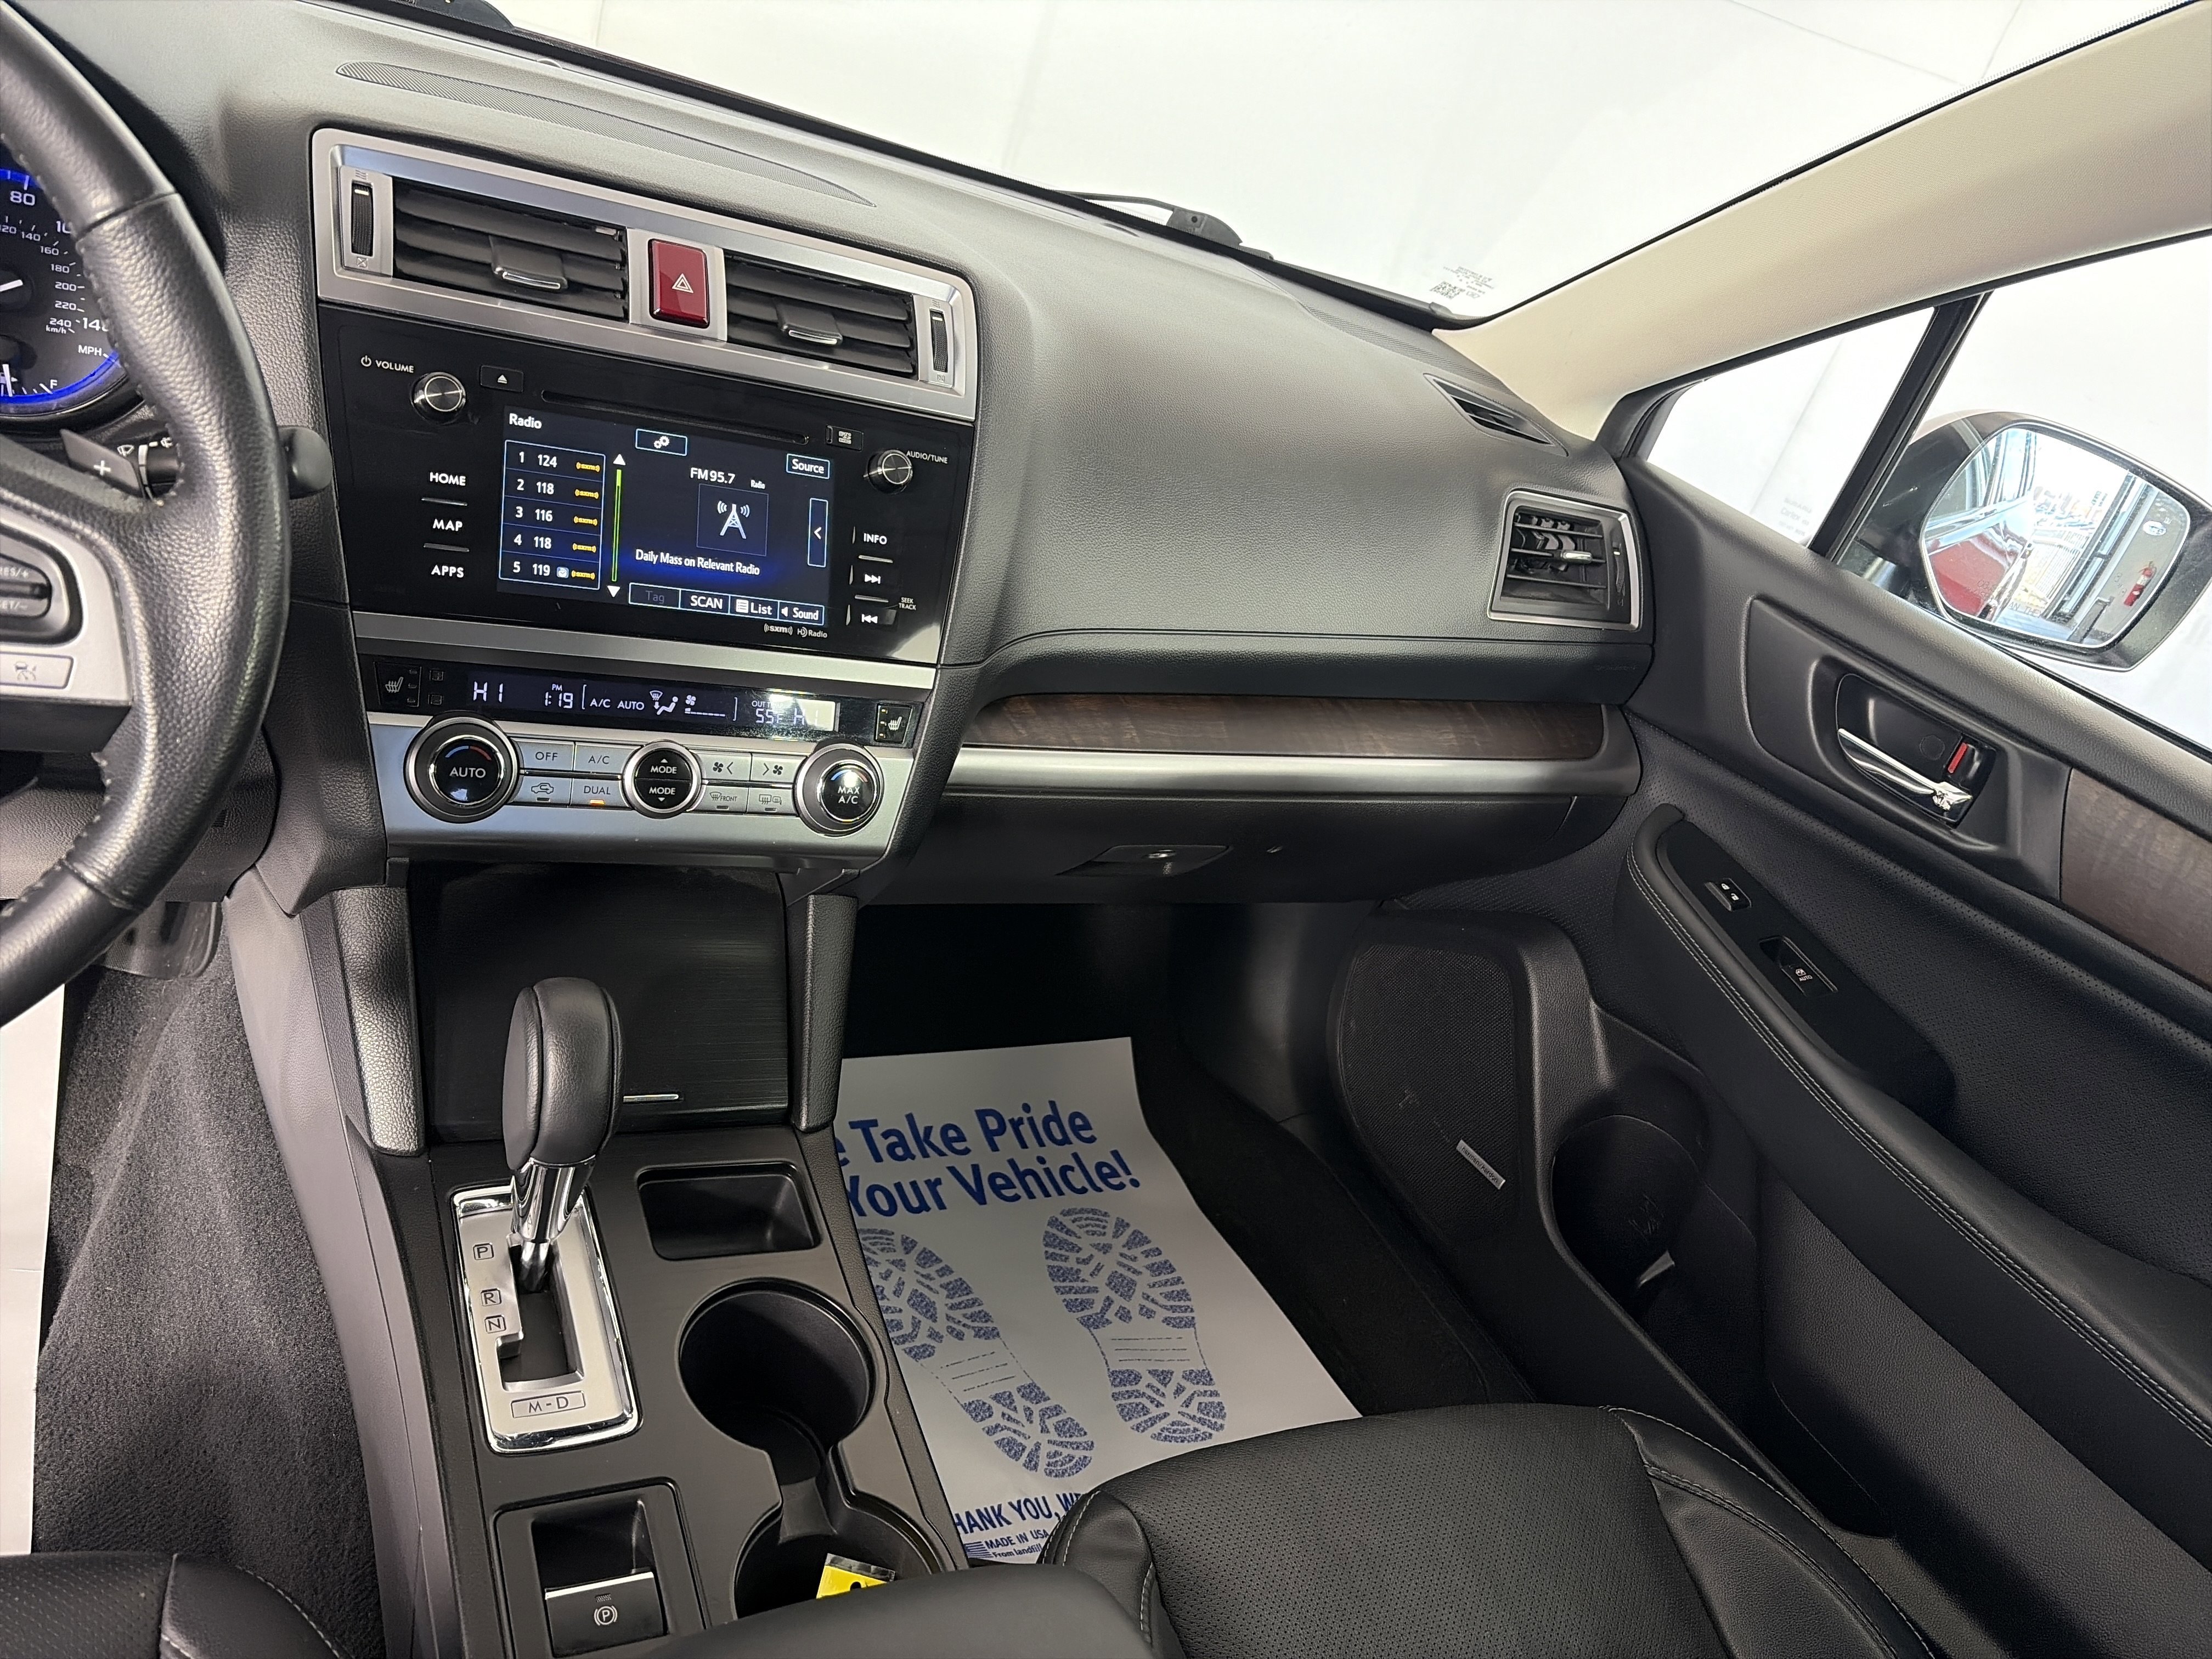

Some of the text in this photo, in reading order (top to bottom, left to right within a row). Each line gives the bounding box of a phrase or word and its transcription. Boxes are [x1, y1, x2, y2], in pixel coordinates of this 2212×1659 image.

[10, 190, 36, 206] 80
[0, 224, 16, 234] 20
[21, 231, 41, 241] 140
[40, 245, 59, 256] 160
[50, 263, 70, 273] 180
[55, 281, 77, 291] 200
[55, 300, 76, 311] 220
[49, 317, 72, 328] 240
[46, 325, 66, 334] km/h
[78, 345, 102, 356] MPH
[375, 359, 414, 374] VOLUME
[50, 379, 58, 389] F
[509, 413, 542, 430] Radio
[519, 452, 525, 464] 1
[537, 454, 557, 469] 124
[906, 450, 948, 464] AUDIO/TUNE
[792, 459, 825, 474] Source
[429, 472, 466, 487] HOME
[751, 479, 765, 489] Radio
[516, 479, 524, 491] 2
[536, 481, 555, 495] 118
[515, 506, 523, 518] 3
[535, 509, 554, 523] 116
[432, 519, 463, 532] MAP
[514, 534, 522, 546] 4
[534, 536, 552, 550] 118
[863, 533, 887, 545] INFO
[635, 549, 760, 575] Daily Mass on Relevant Radio
[431, 565, 464, 579] APPS
[513, 562, 521, 574] 5
[532, 564, 551, 578] 119
[646, 590, 665, 604] Tag
[690, 595, 723, 610] SCAN
[751, 603, 772, 616] List
[898, 602, 917, 611] TRACK
[792, 607, 819, 620] Sound
[808, 629, 827, 638] Radio
[544, 692, 573, 709] 1:19
[590, 698, 645, 710] A/C AUTO
[535, 751, 558, 761] OFF
[588, 755, 610, 765] A/C
[449, 768, 486, 778] AUTO
[650, 764, 678, 775] MODE
[583, 785, 611, 795] DUAL
[648, 786, 676, 796] MODE
[838, 785, 860, 794] MAX
[838, 795, 859, 804] A/C
[848, 1113, 972, 1163] Take
[974, 1100, 1097, 1152] Pride
[847, 1149, 1140, 1217] Your Vehicle!
[476, 1246, 489, 1259] P
[484, 1292, 495, 1305] R
[488, 1319, 501, 1331] N
[954, 1503, 1012, 1534] HANK
[1008, 1496, 1061, 1521] YOU,
[984, 1528, 1050, 1549] MADE IN USA
